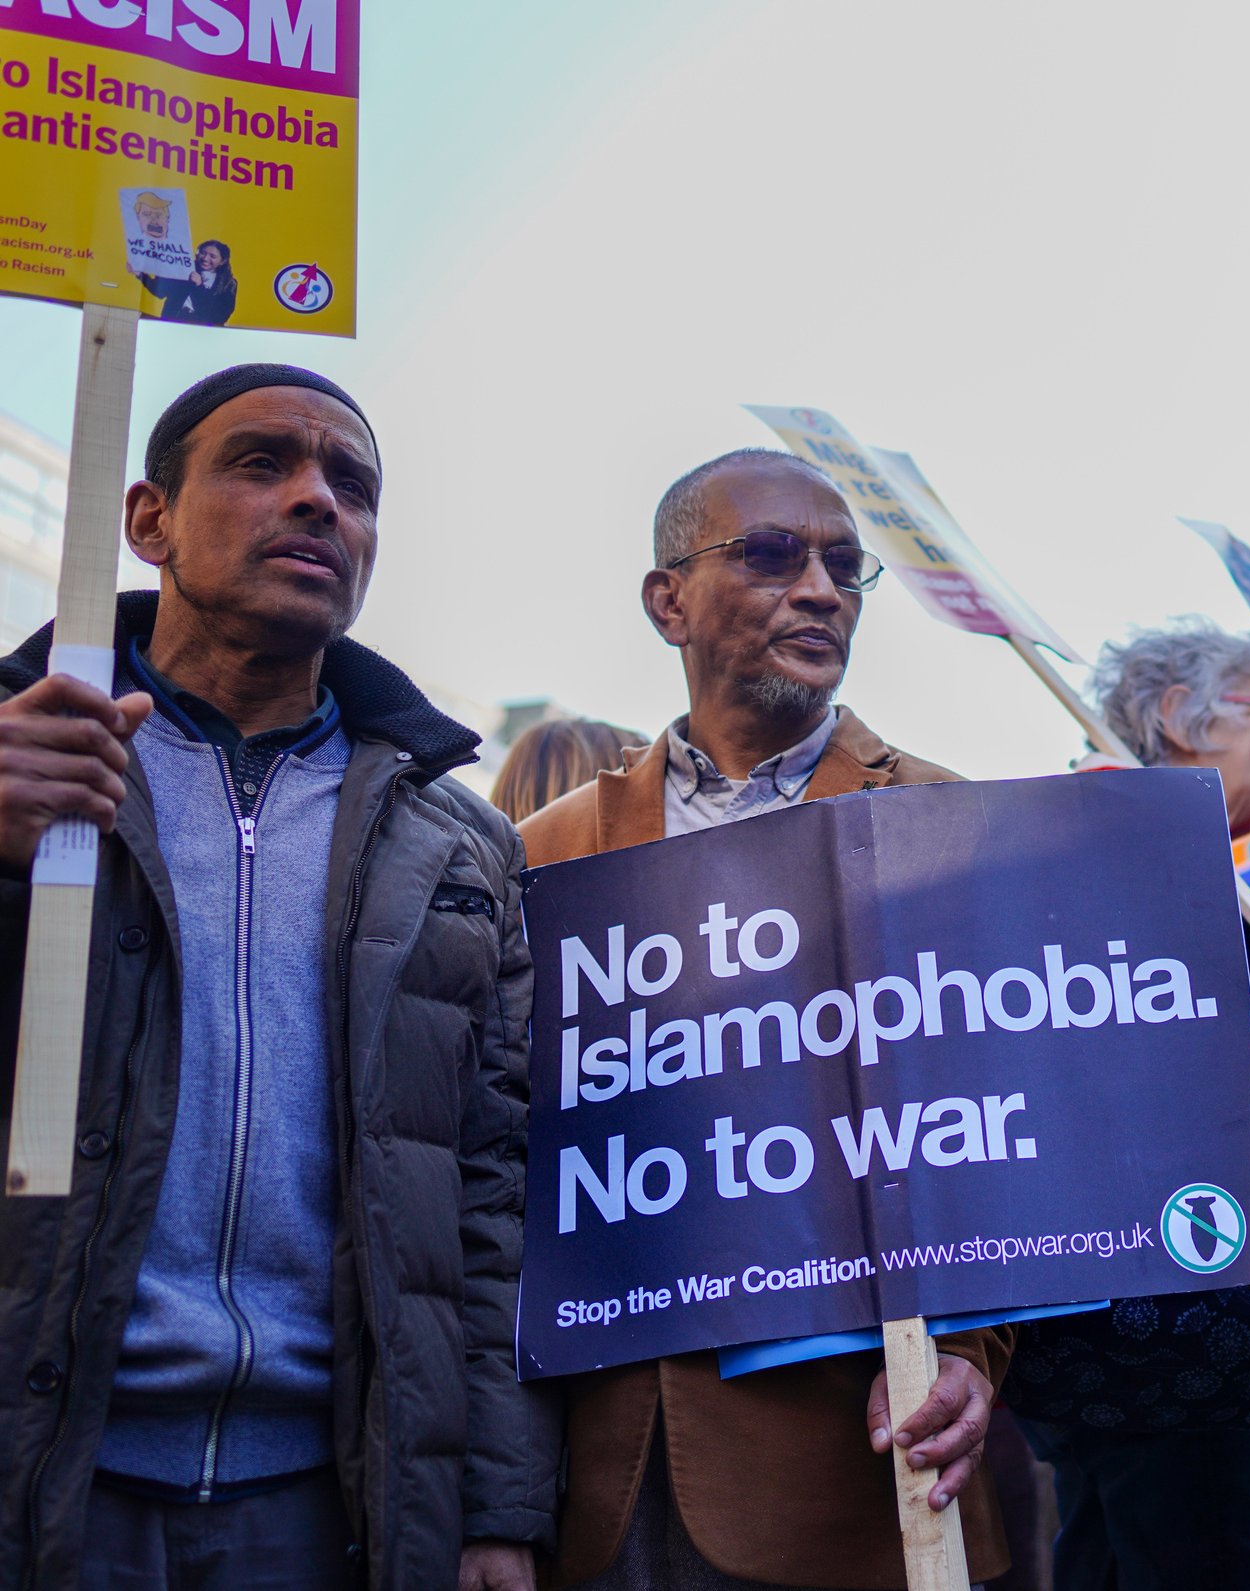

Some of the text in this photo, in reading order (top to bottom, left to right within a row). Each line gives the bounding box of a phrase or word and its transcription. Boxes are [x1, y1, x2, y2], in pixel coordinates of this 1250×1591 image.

[0, 0, 337, 75] ISM
[0, 56, 339, 149] o Islamophobia
[2, 110, 294, 191] antisemitism
[12, 258, 66, 277] Racism
[127, 238, 190, 255] WE SHALL
[130, 247, 192, 268] OVERCOMB
[560, 902, 801, 1019] No to
[560, 940, 1219, 1111] Islamophobia.
[558, 1092, 1038, 1235] No to war.
[556, 1222, 1155, 1328] Stop the War Coalition. www.stopwar.org.uk
